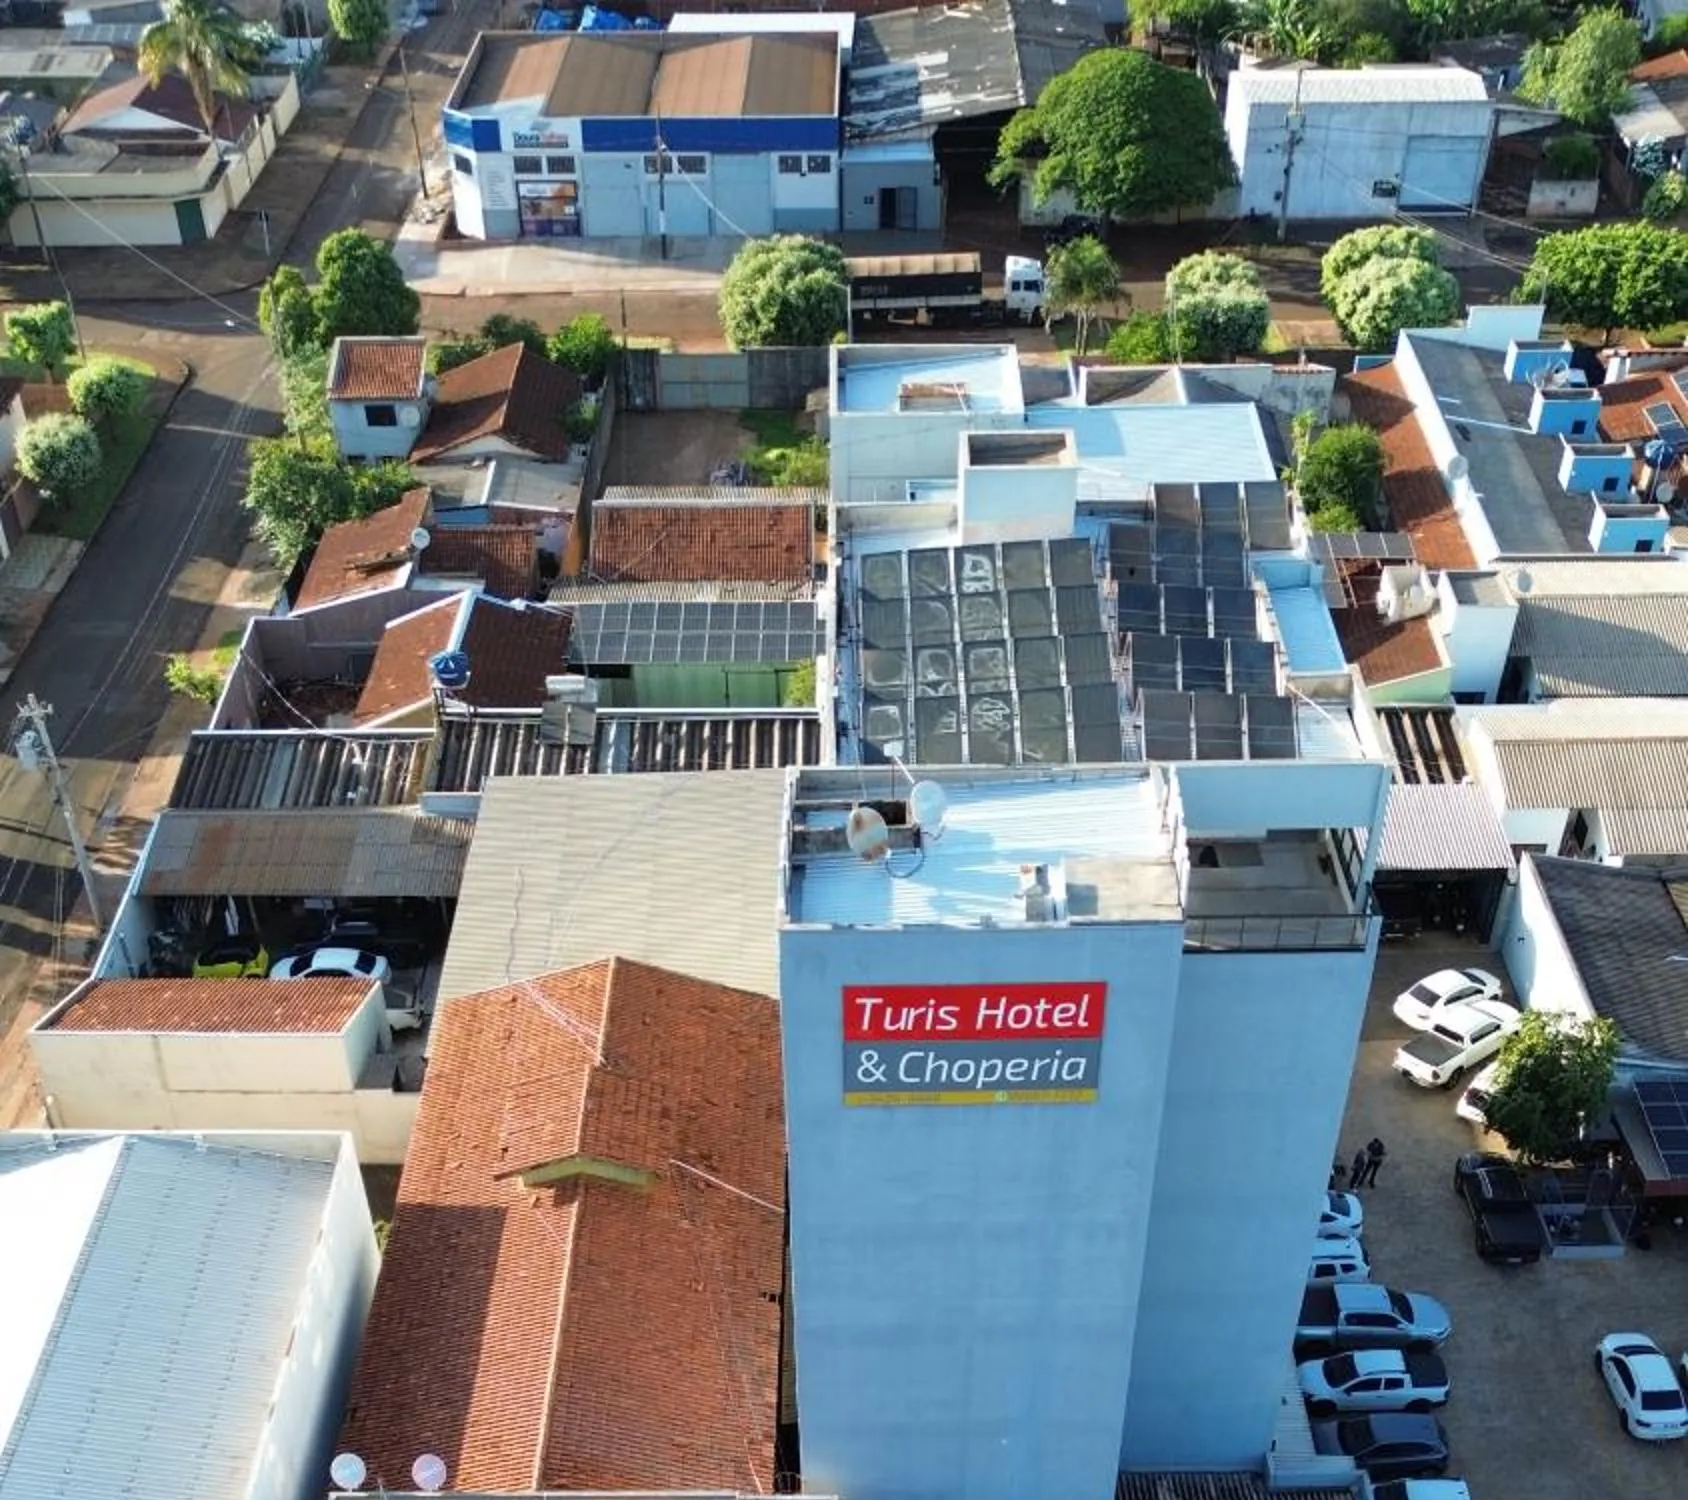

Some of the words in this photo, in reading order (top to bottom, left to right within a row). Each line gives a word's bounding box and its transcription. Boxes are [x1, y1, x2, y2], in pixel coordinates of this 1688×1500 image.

[855, 997, 960, 1031] Turis
[975, 993, 1090, 1030] Hotel
[856, 1049, 887, 1083] &
[898, 1049, 1087, 1089] Choperia
